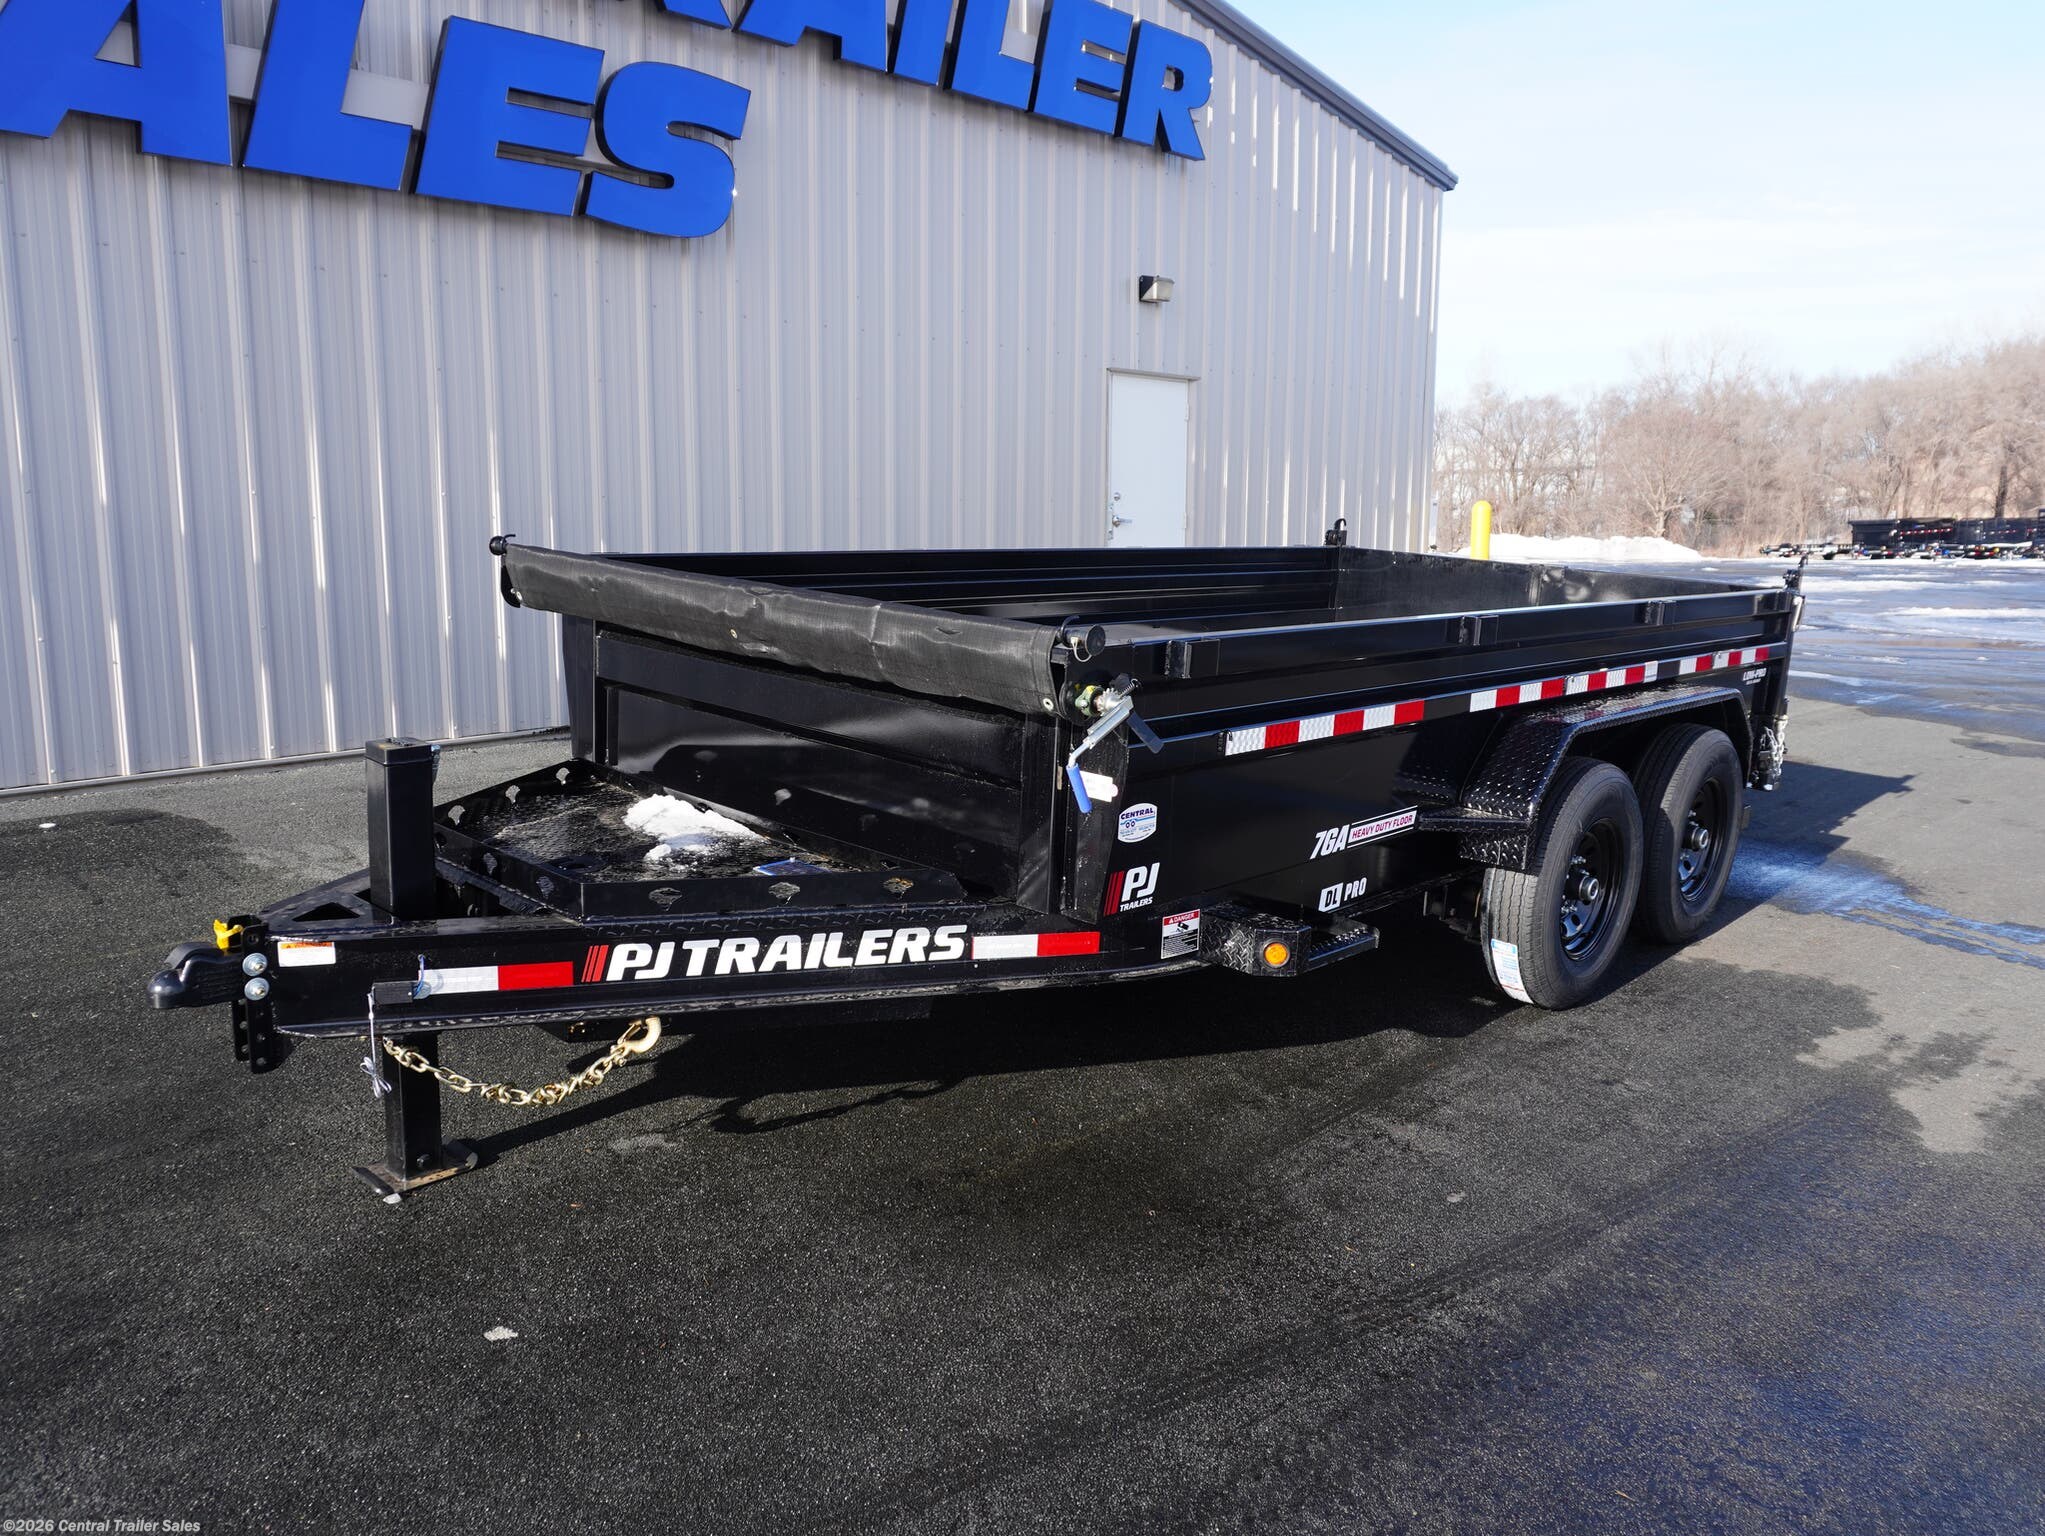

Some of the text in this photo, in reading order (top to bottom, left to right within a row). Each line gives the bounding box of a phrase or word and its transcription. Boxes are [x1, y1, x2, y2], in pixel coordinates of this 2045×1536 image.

[0, 0, 751, 238] ALES
[1120, 807, 1154, 820] CENTRAL
[1310, 814, 1413, 860] 7GA HEAVY DUTY FLOOR
[1121, 862, 1160, 902] PJ
[1344, 877, 1367, 902] PRO
[1120, 897, 1153, 912] TRAILERS
[1173, 911, 1195, 923] DANGER
[606, 924, 968, 982] PJ TRAILERS
